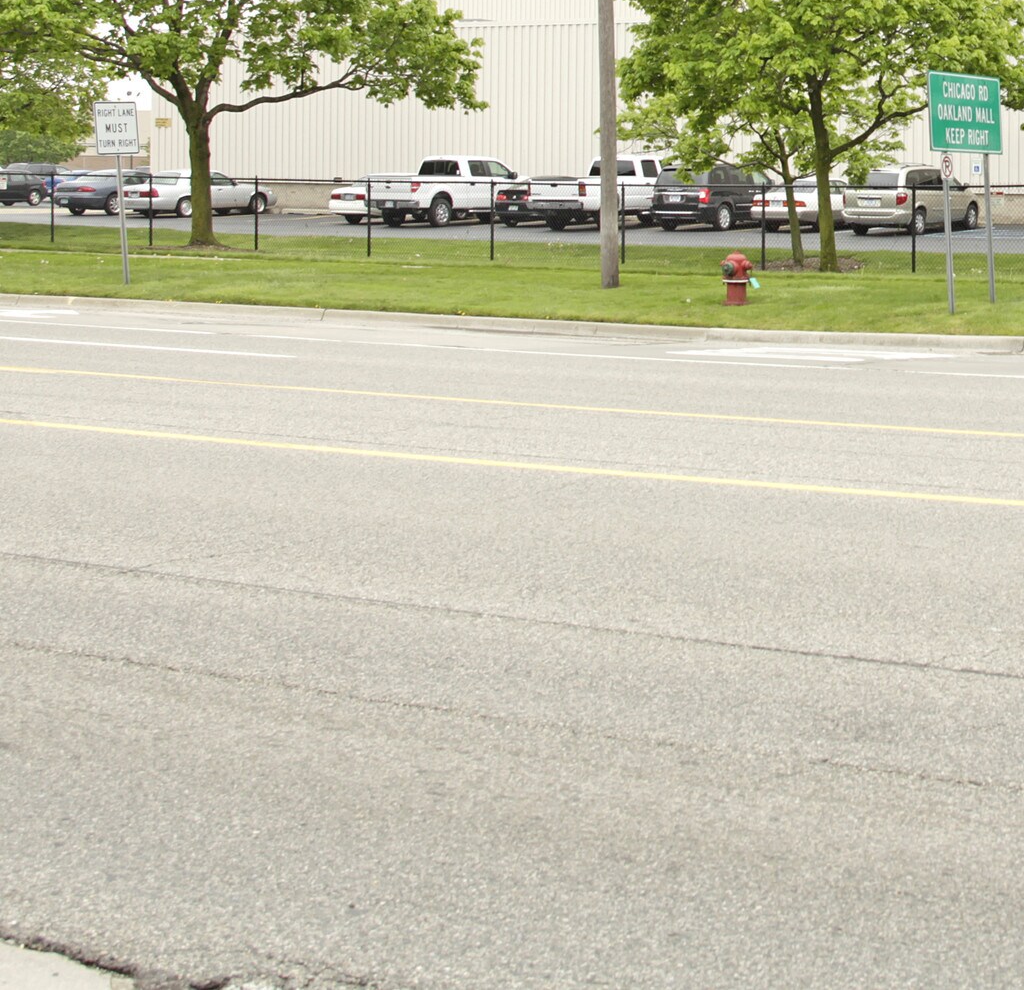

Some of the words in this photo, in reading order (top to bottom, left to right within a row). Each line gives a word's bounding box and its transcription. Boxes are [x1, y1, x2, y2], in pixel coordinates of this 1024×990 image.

[942, 81, 976, 101] CHICAGO
[978, 85, 988, 102] RD
[97, 108, 116, 117] RIGHT
[118, 108, 135, 117] LANE
[937, 103, 973, 122] OAKLAND
[975, 108, 995, 124] MALL
[105, 123, 128, 133] MUST
[99, 139, 116, 148] TURN
[118, 138, 137, 147] RIGHT
[945, 127, 965, 145] KEEP
[967, 130, 989, 146] RIGHT
